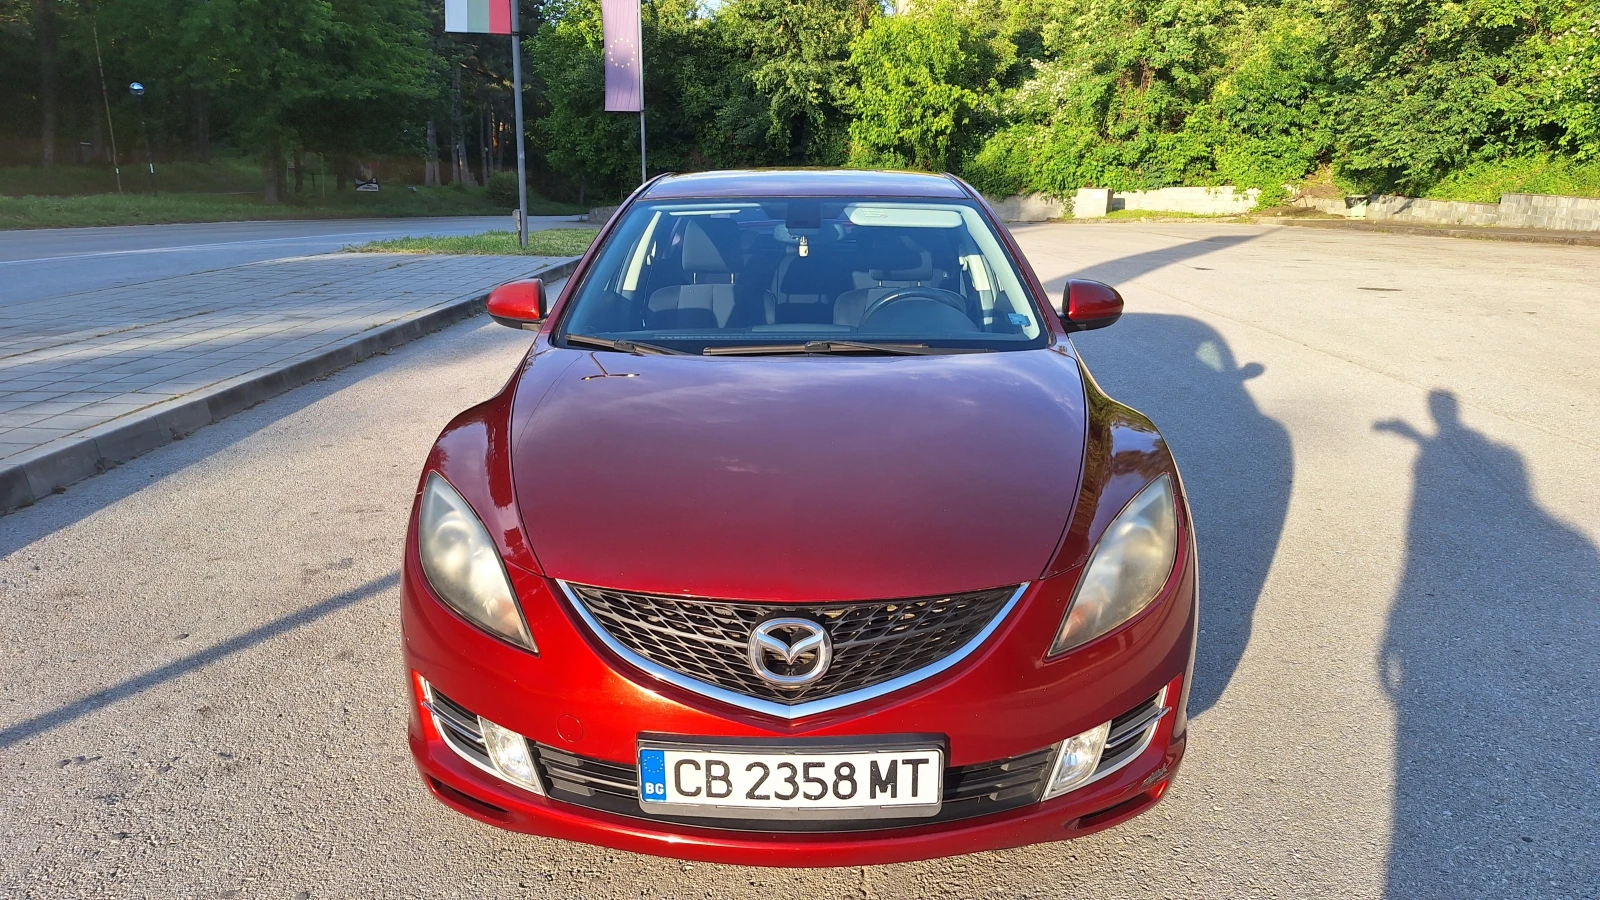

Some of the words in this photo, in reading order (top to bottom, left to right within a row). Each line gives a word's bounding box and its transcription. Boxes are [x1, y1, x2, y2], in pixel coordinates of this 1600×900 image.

[645, 782, 665, 795] BG
[674, 758, 733, 798] CB
[745, 761, 858, 801] 2358
[869, 758, 930, 800] MT
